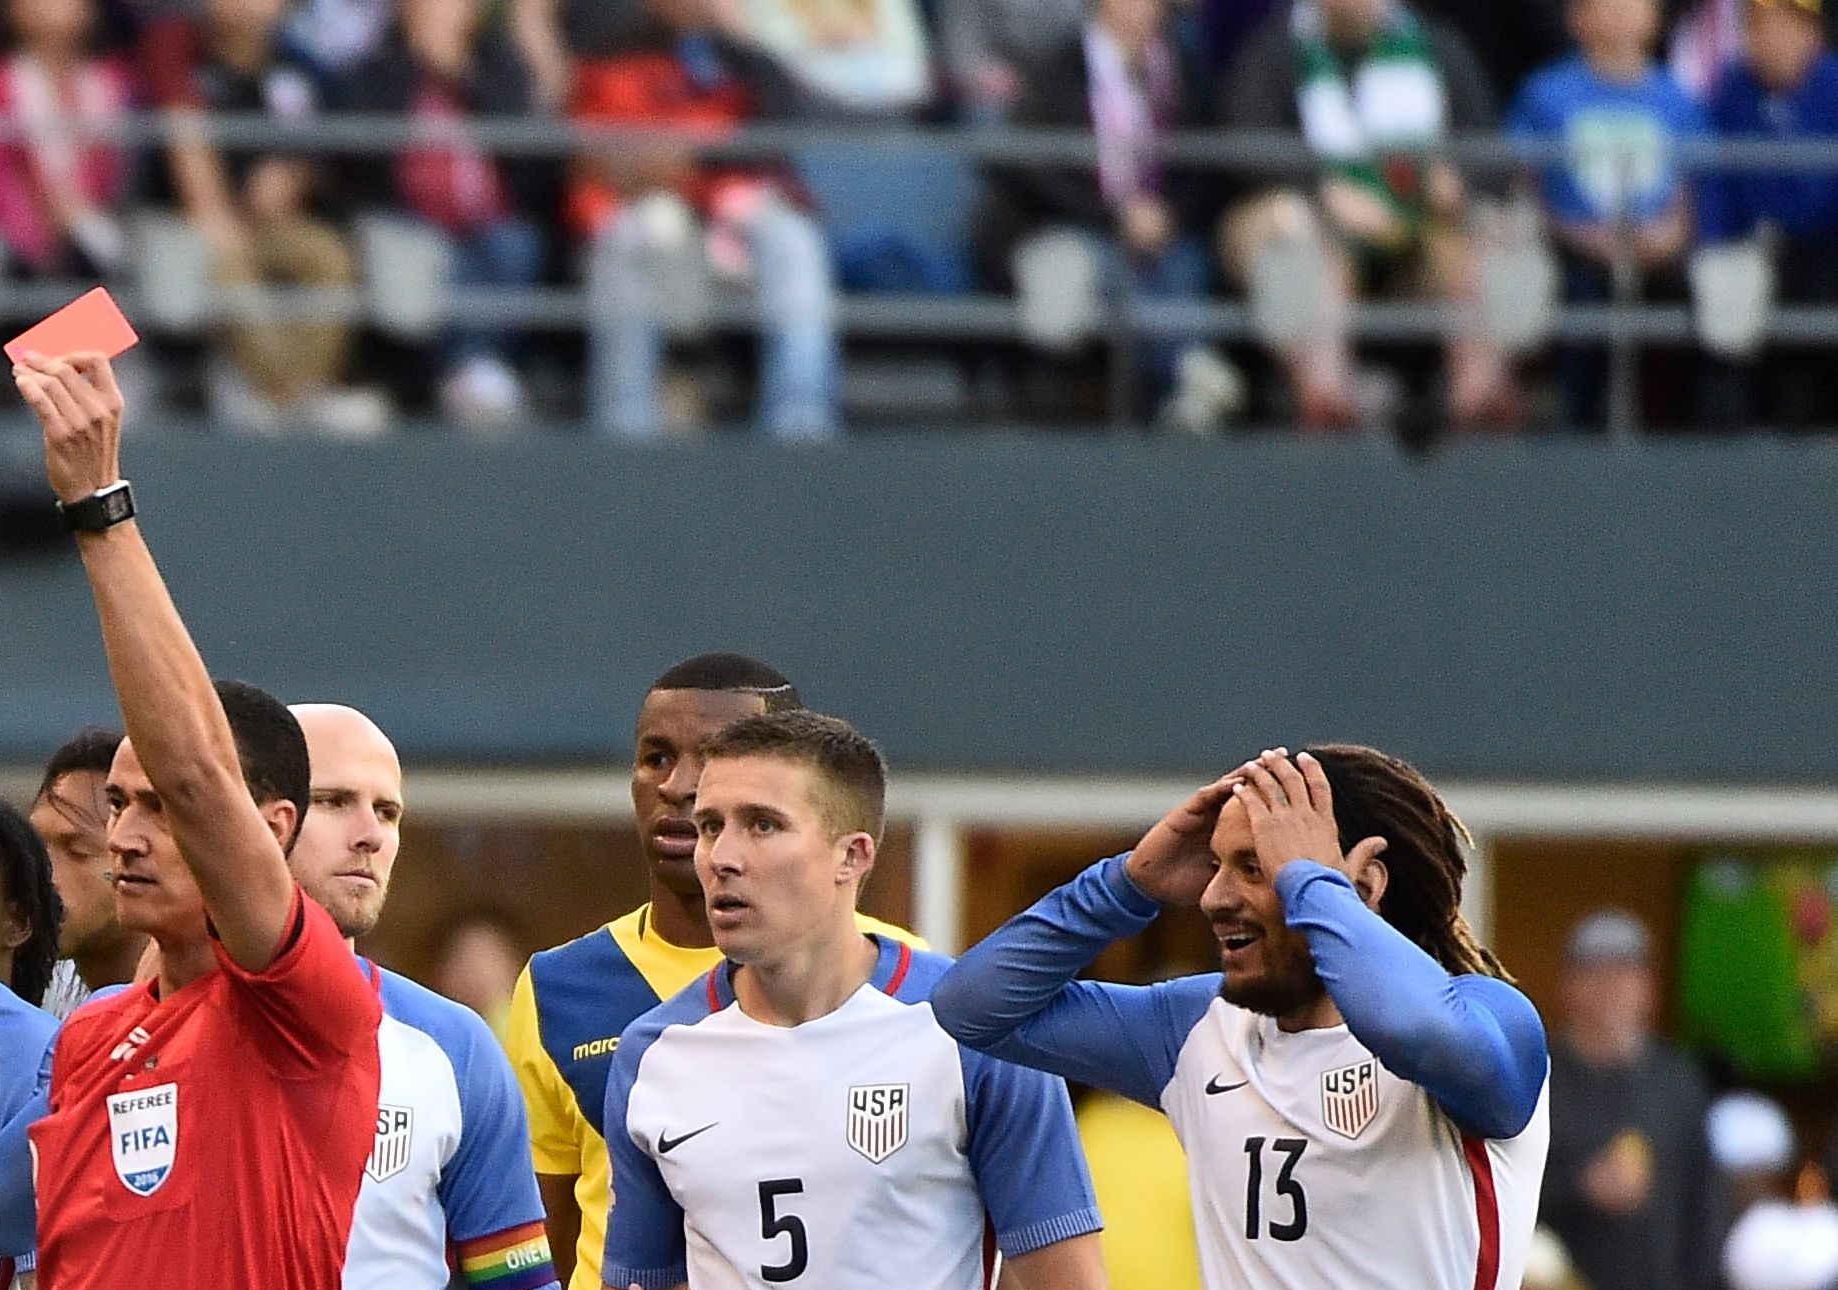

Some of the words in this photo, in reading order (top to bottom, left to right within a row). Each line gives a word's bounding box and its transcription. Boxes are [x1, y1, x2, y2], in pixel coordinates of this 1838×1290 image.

[1326, 1062, 1372, 1095] USA
[113, 1091, 173, 1116] REFEREE
[853, 1088, 904, 1117] USA
[377, 1108, 408, 1136] SA
[120, 1124, 170, 1156] FIFA
[1243, 1135, 1309, 1243] 13
[757, 1177, 809, 1284] 5
